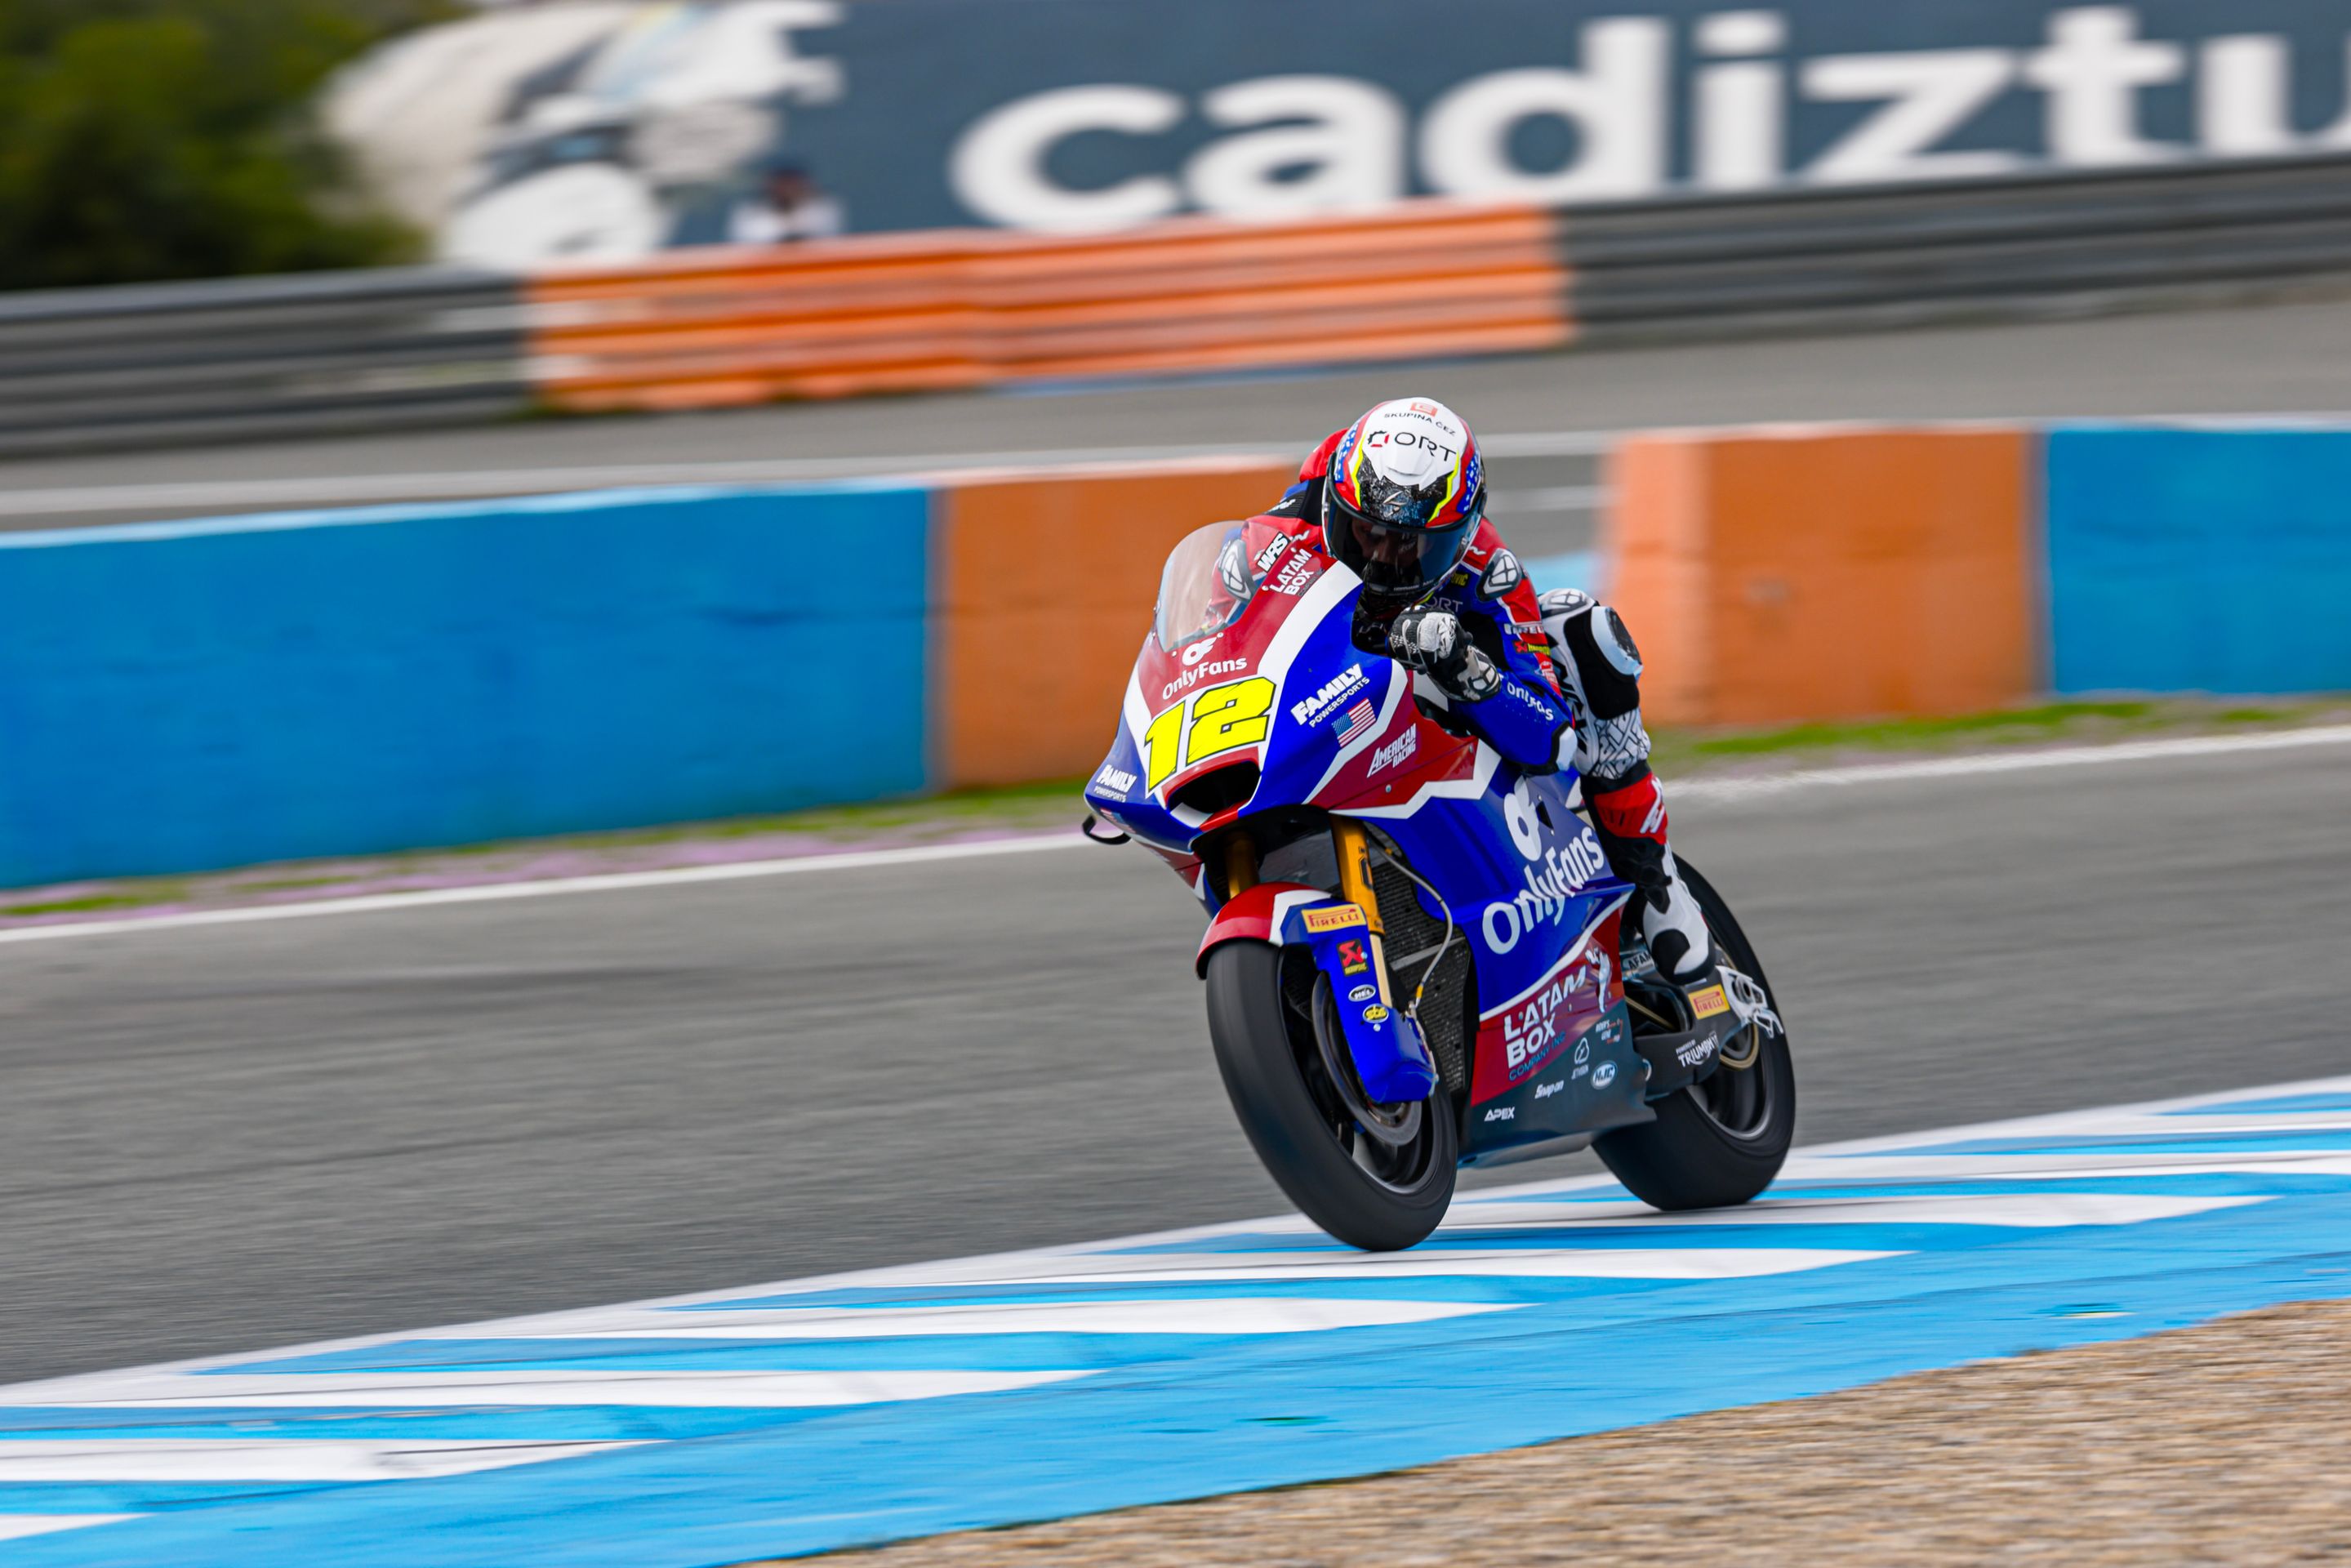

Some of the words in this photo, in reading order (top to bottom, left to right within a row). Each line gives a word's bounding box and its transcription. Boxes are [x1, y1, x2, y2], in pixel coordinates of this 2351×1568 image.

[1384, 412, 1432, 424] SKUPINA
[1258, 532, 1289, 572] WRS
[1269, 548, 1313, 593] LATAM
[1283, 569, 1315, 595] BOX
[1162, 657, 1248, 701] OnlyFans
[1290, 663, 1363, 725] FAMILY
[1308, 676, 1370, 728] POWERSPORTS
[1144, 676, 1276, 793] 12
[1367, 723, 1417, 778] AMERICAN
[1392, 741, 1417, 768] RACING
[1096, 764, 1138, 793] FAMILY
[1482, 826, 1605, 955] OnlyFans
[1307, 909, 1360, 928] PIRELLI
[1503, 965, 1587, 1041] LATAM
[1693, 991, 1725, 1013] PIRELLI
[1507, 1013, 1556, 1068] BOX
[1678, 1036, 1716, 1067] TRIUMPH
[1509, 1045, 1550, 1081] COMPANY
[1484, 1107, 1516, 1122] APEX
